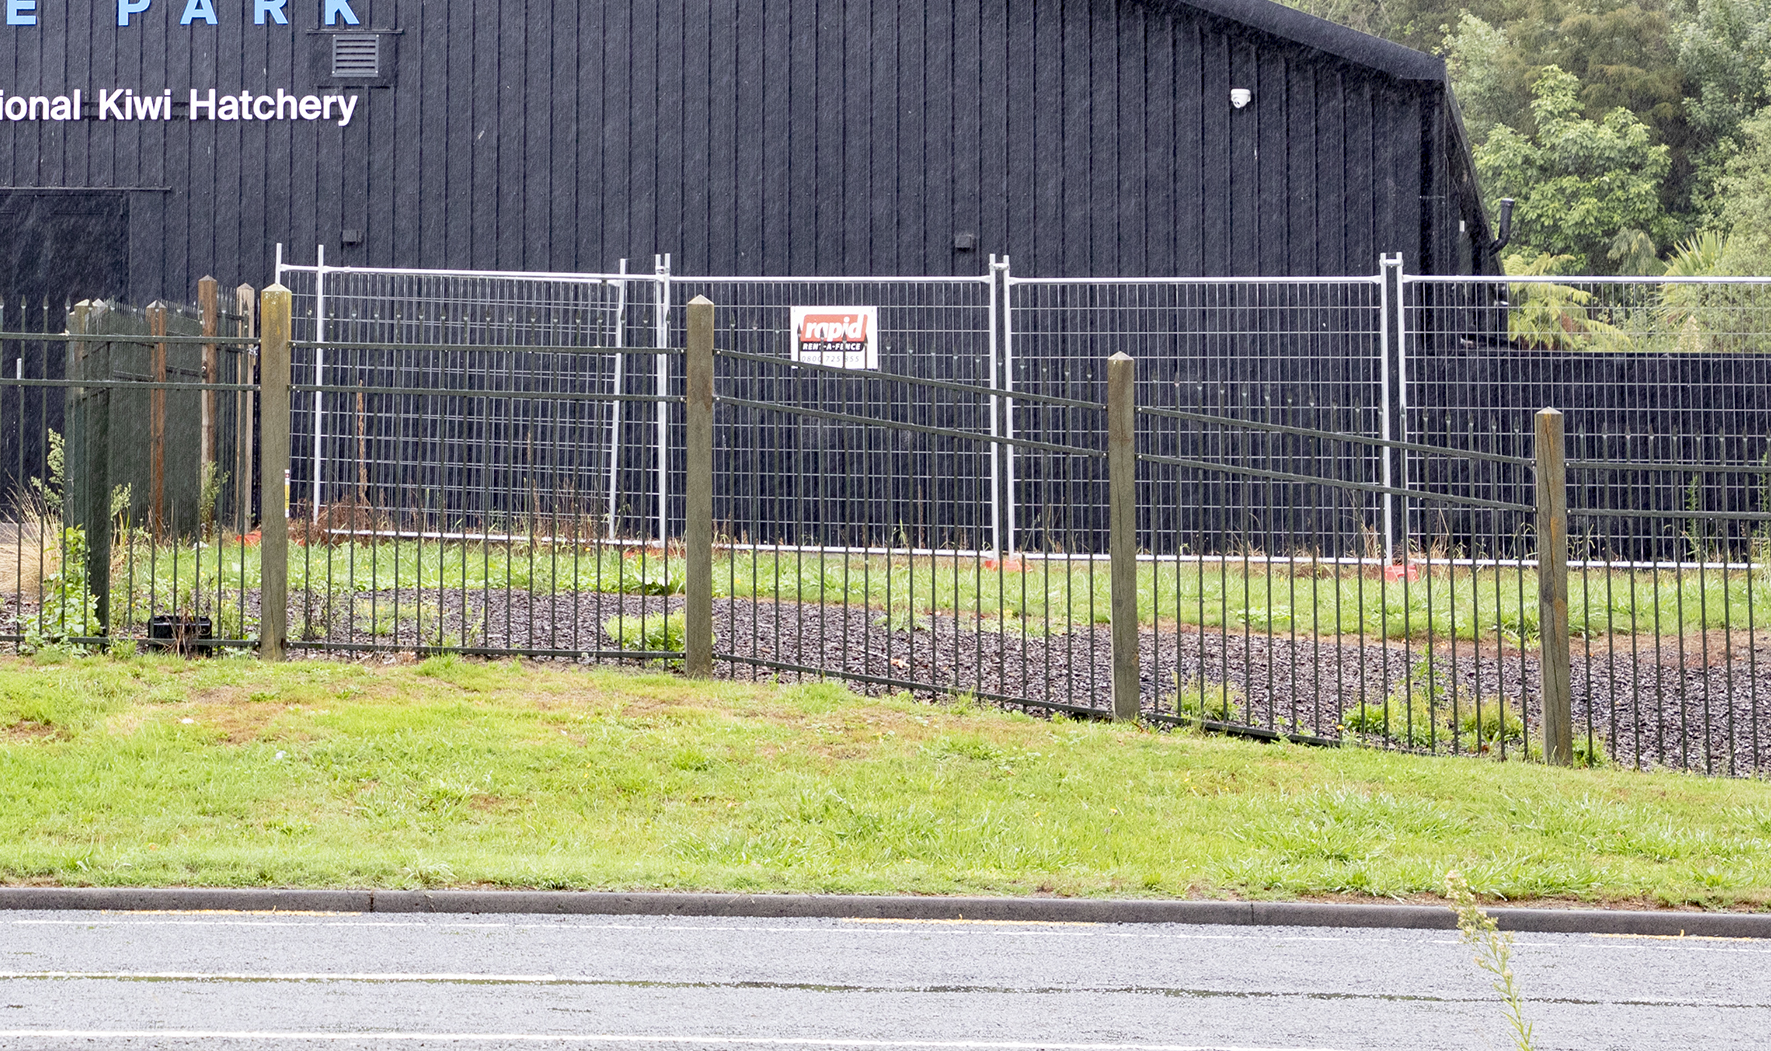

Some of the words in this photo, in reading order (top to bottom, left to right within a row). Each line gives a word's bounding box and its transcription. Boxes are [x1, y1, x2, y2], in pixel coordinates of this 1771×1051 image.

[99, 88, 172, 120] Kiwi
[189, 87, 359, 127] Hatchery
[805, 314, 865, 342] rapid
